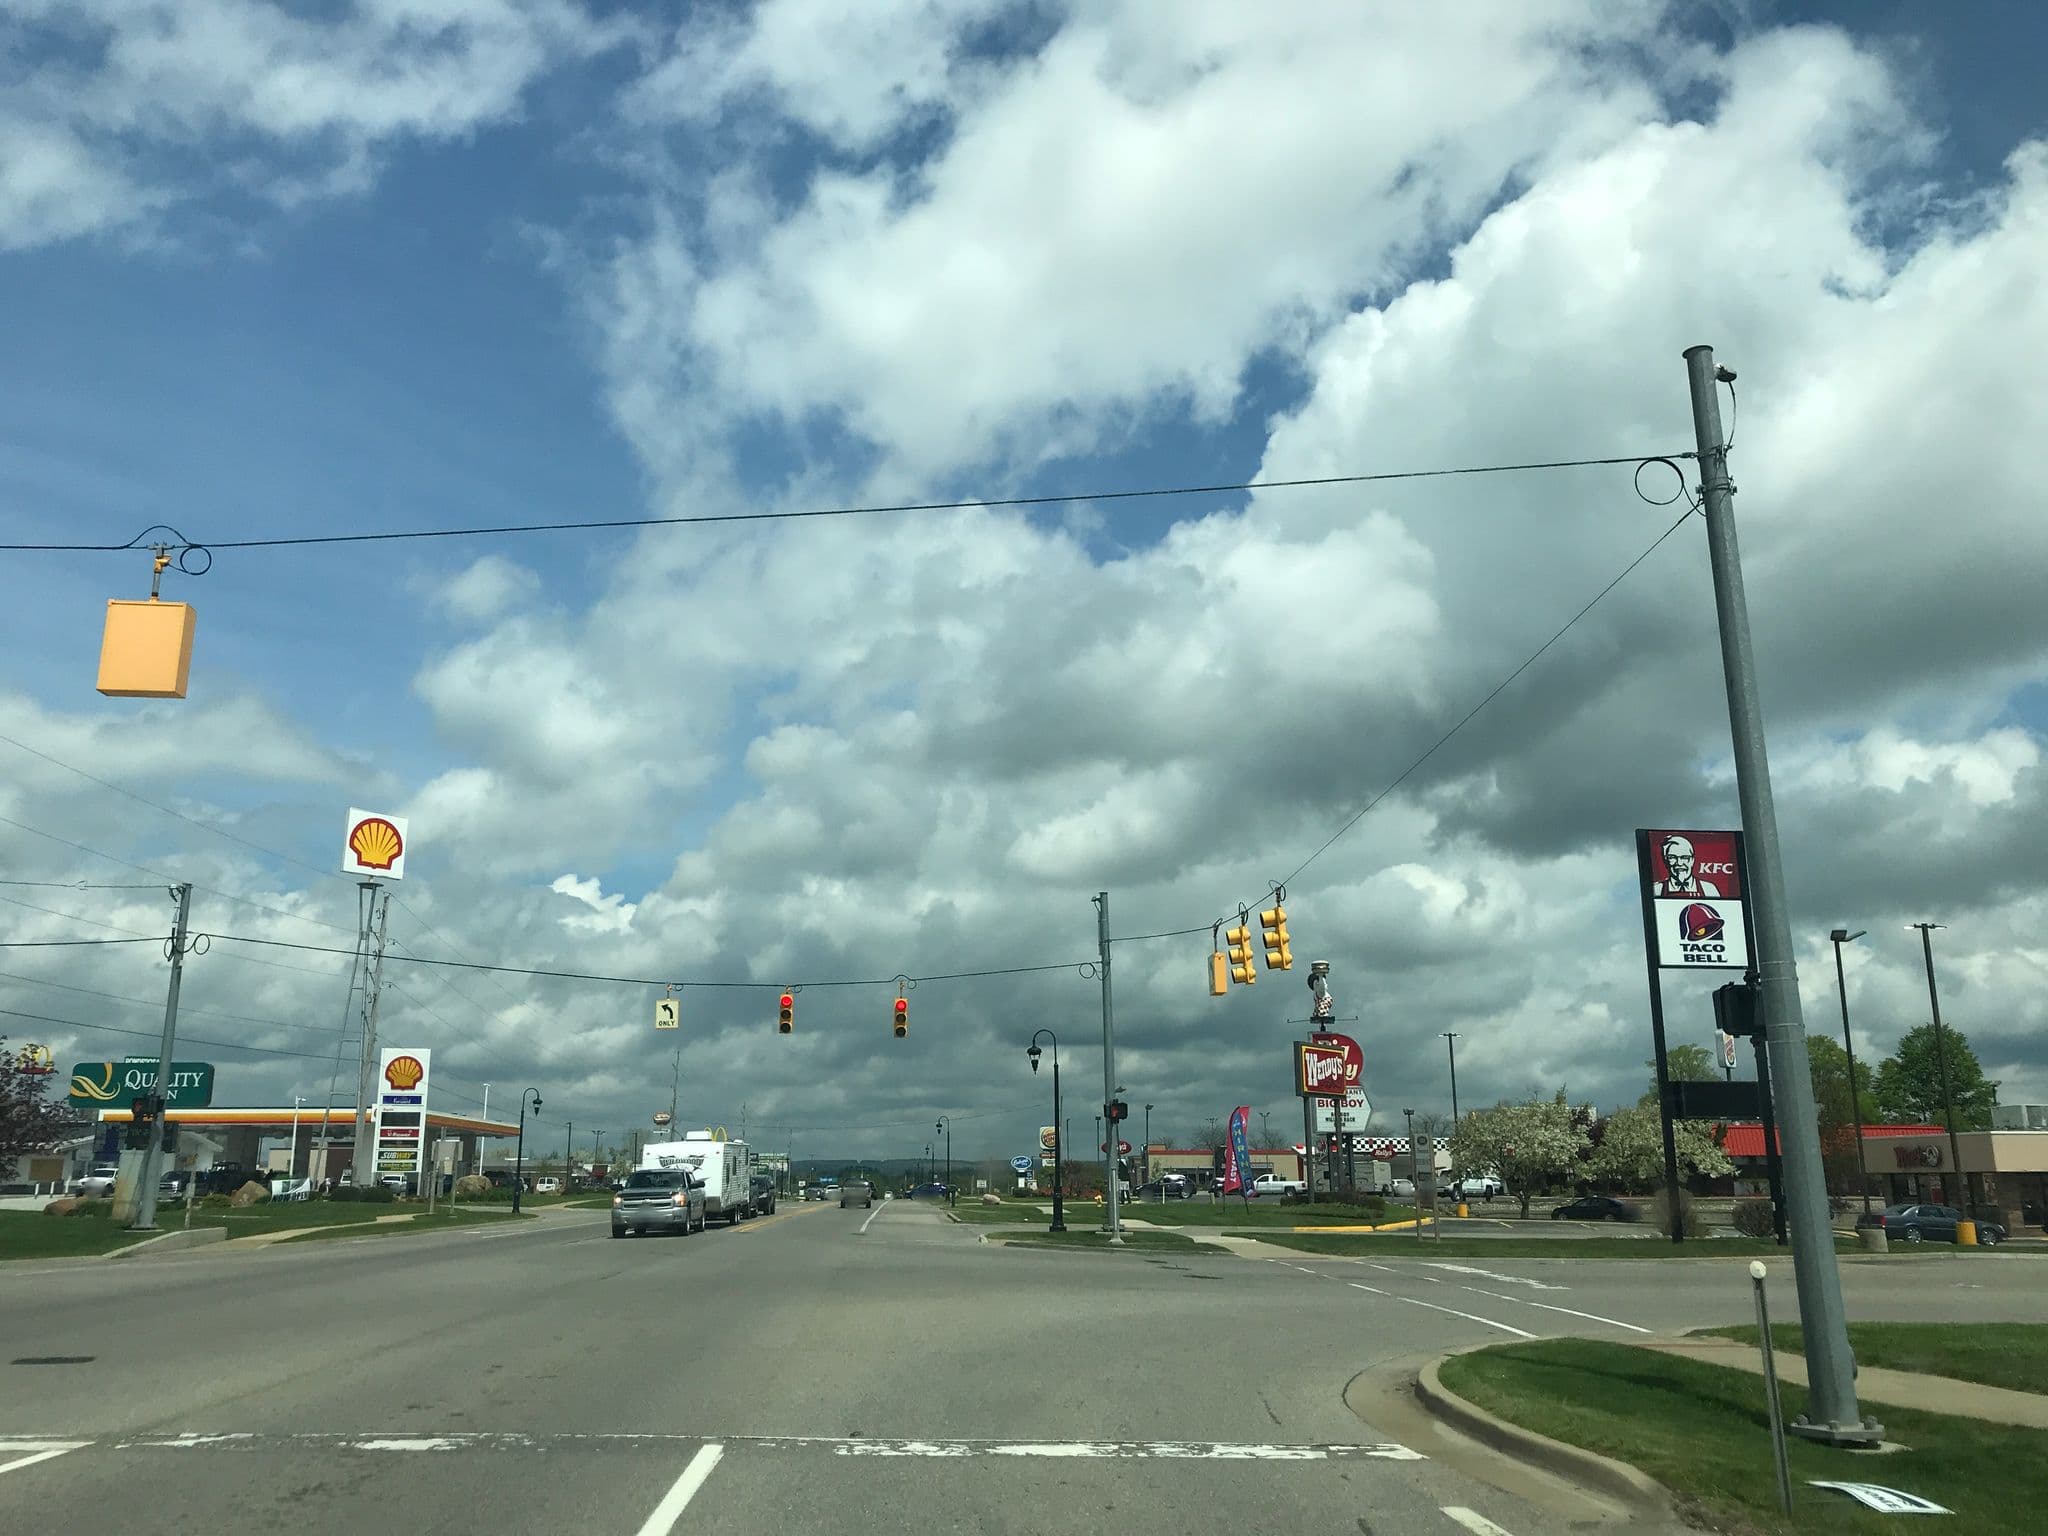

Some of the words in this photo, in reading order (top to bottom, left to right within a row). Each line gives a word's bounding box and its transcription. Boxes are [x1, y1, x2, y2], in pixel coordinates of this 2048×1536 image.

[1698, 862, 1734, 874] KFC
[1679, 943, 1726, 953] TACO
[1684, 954, 1728, 963] BELL
[1340, 1099, 1364, 1108] BOY
